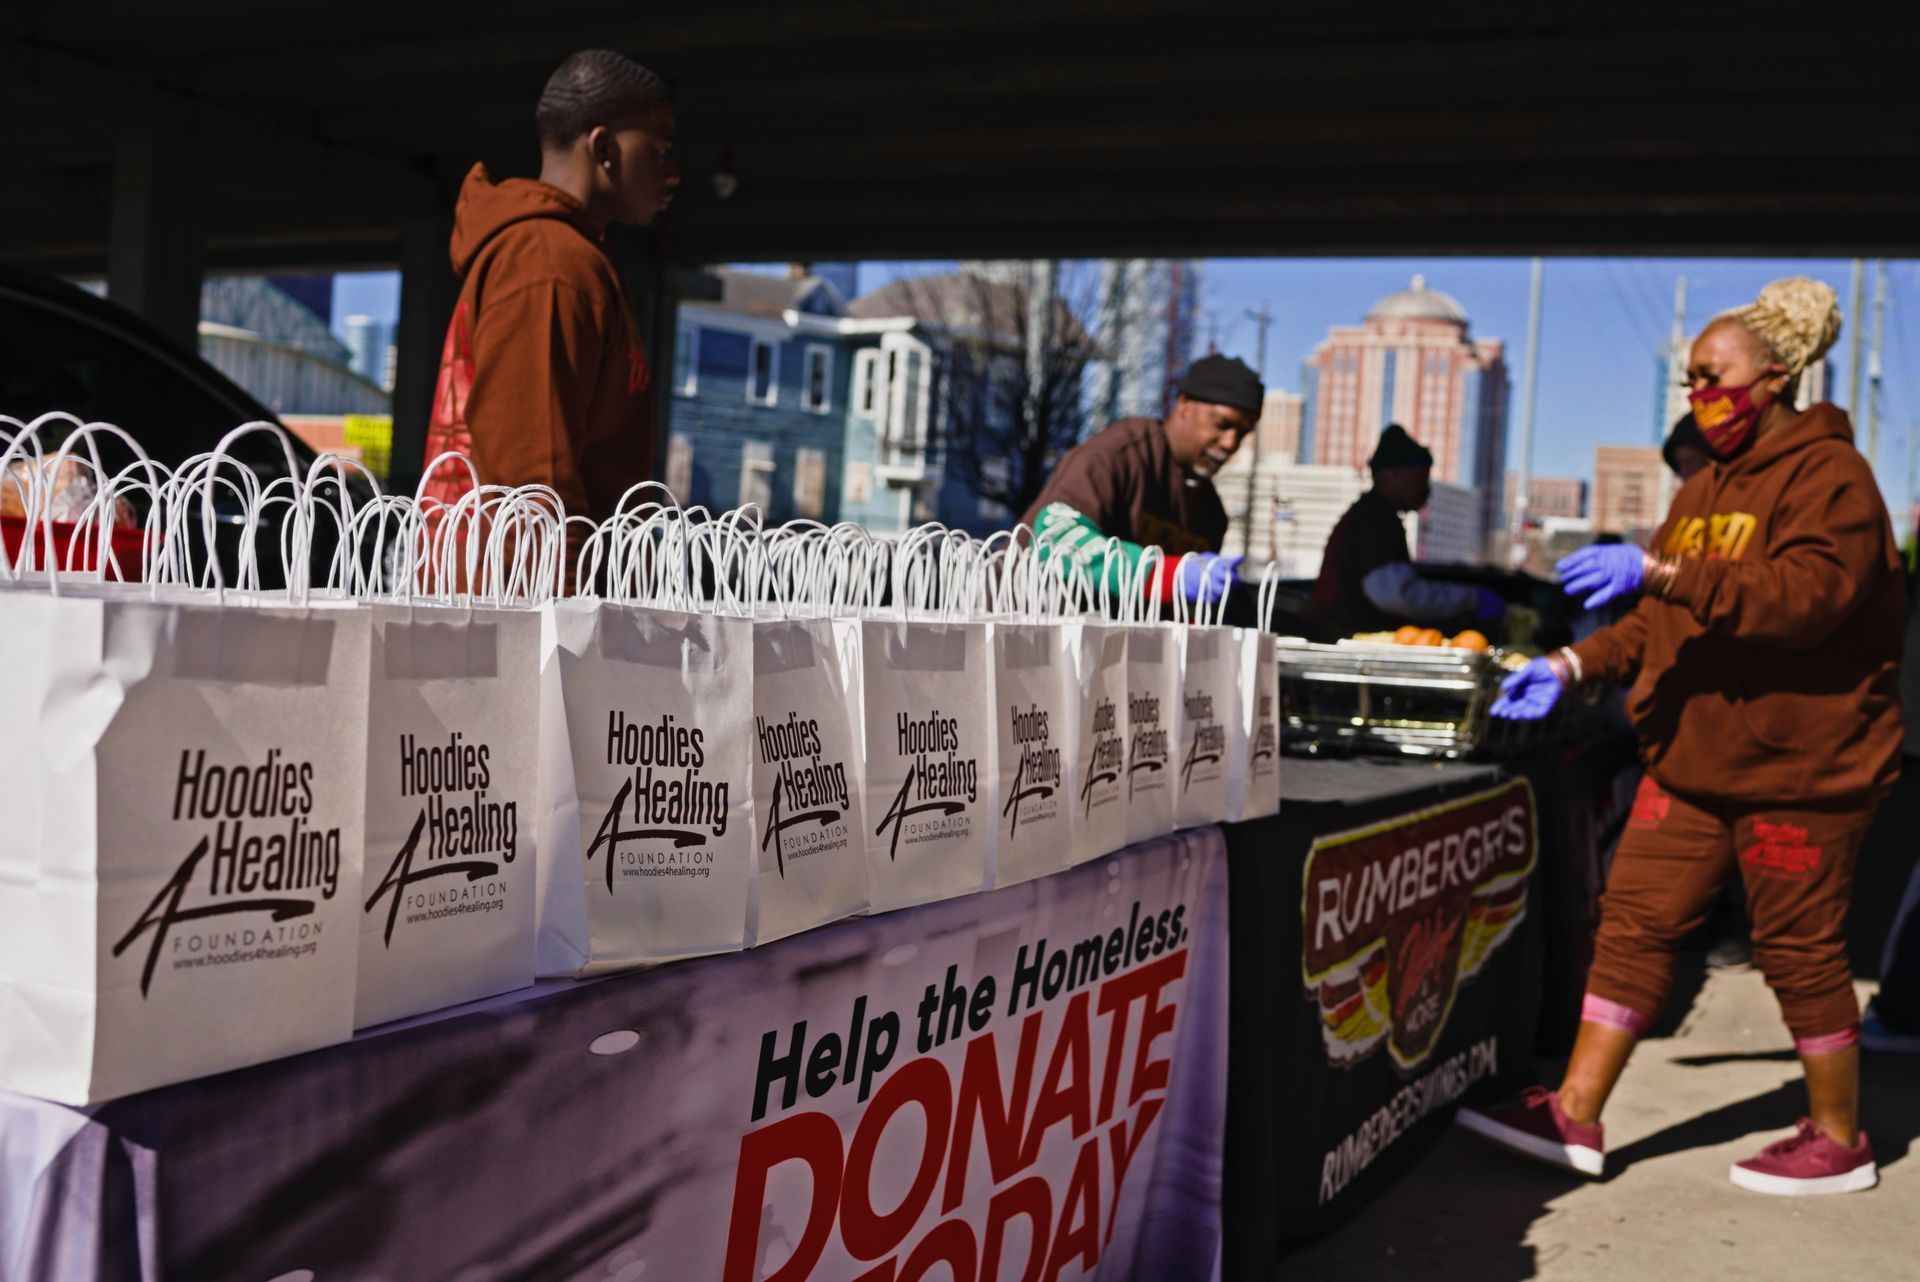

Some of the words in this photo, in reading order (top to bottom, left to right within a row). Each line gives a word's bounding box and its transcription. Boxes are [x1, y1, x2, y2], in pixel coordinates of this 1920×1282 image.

[897, 710, 958, 755] Hoodies
[1011, 703, 1049, 745] Hoodies
[1128, 691, 1160, 725] Hoodies
[400, 732, 490, 797] Hoodies
[607, 710, 704, 767] Hoodies
[756, 711, 822, 764] Hoodies
[1023, 741, 1061, 788] Healing
[1137, 723, 1168, 763] Healing
[172, 749, 313, 820] Hoodies
[634, 767, 729, 836] Healing
[781, 755, 849, 811] Healing
[917, 752, 976, 802] Healing
[1003, 753, 1054, 841] 4
[427, 792, 517, 863] Healing
[587, 776, 707, 895] 4
[762, 772, 841, 880] 4
[783, 825, 848, 849] FOUNDATION
[876, 764, 965, 862] 4
[904, 816, 971, 835] FOUNDATION
[209, 817, 341, 899] Healing
[620, 852, 714, 864] FOUNDATION
[622, 866, 710, 878] www.hoodies4healing.org
[787, 839, 847, 860] www.hoodies4healing.org
[365, 808, 499, 949] 4
[407, 881, 507, 909] FOUNDATION
[112, 836, 316, 999] 4
[173, 922, 323, 952] FOUNDATION
[406, 899, 504, 923] www.hoodies4healing.org
[173, 942, 317, 970] www.hoodies4healing.org
[751, 995, 900, 1122] Help
[917, 964, 996, 1054] the
[1007, 901, 1189, 1017] Homeless.
[723, 949, 1188, 1282] DONATE
[850, 1098, 1166, 1282] DAY
